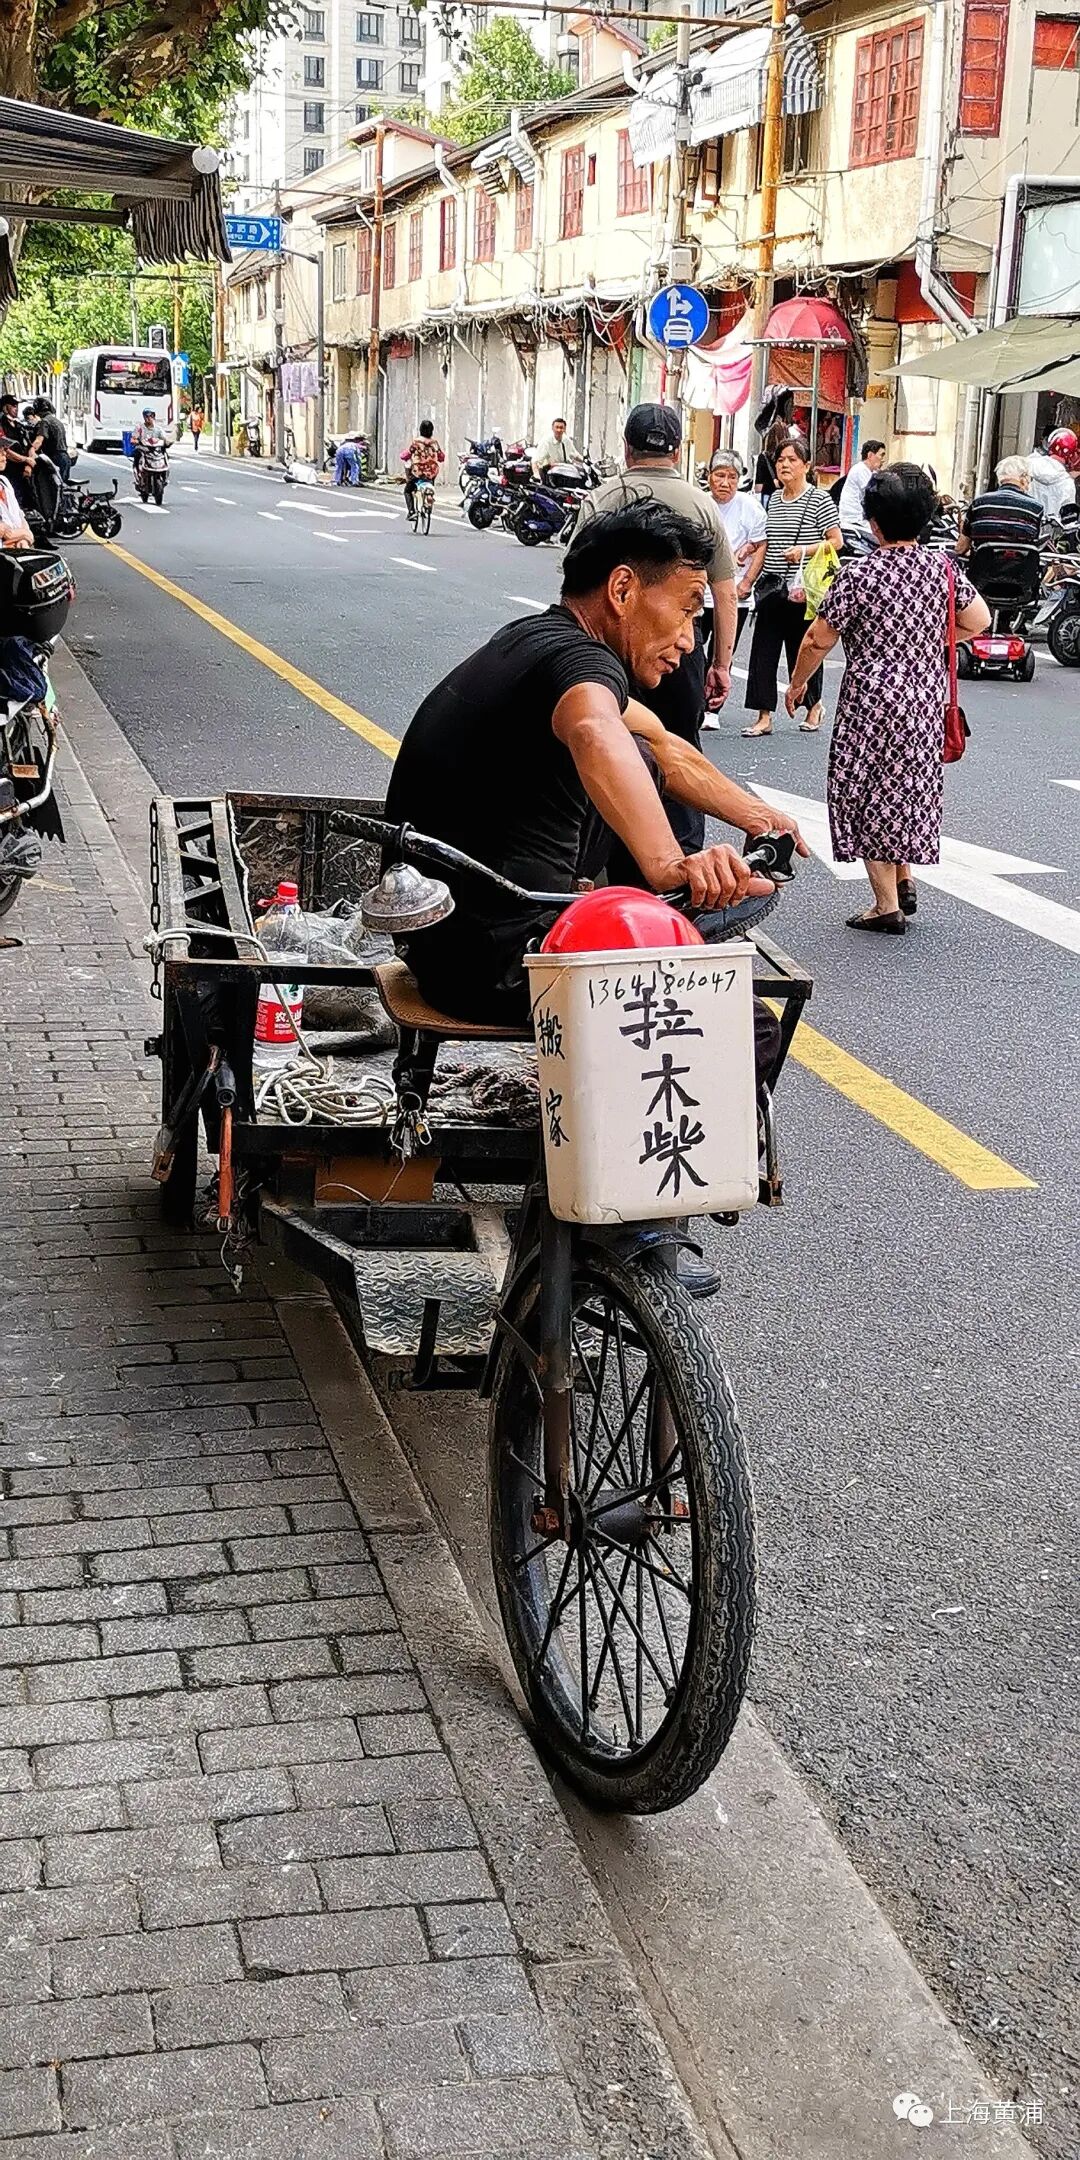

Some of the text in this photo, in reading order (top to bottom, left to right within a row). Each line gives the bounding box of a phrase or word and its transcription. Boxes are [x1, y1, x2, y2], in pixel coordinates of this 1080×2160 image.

[588, 970, 736, 1008] 13641806047
[537, 1007, 570, 1147] 搬家
[619, 987, 709, 1198] 拉木柴
